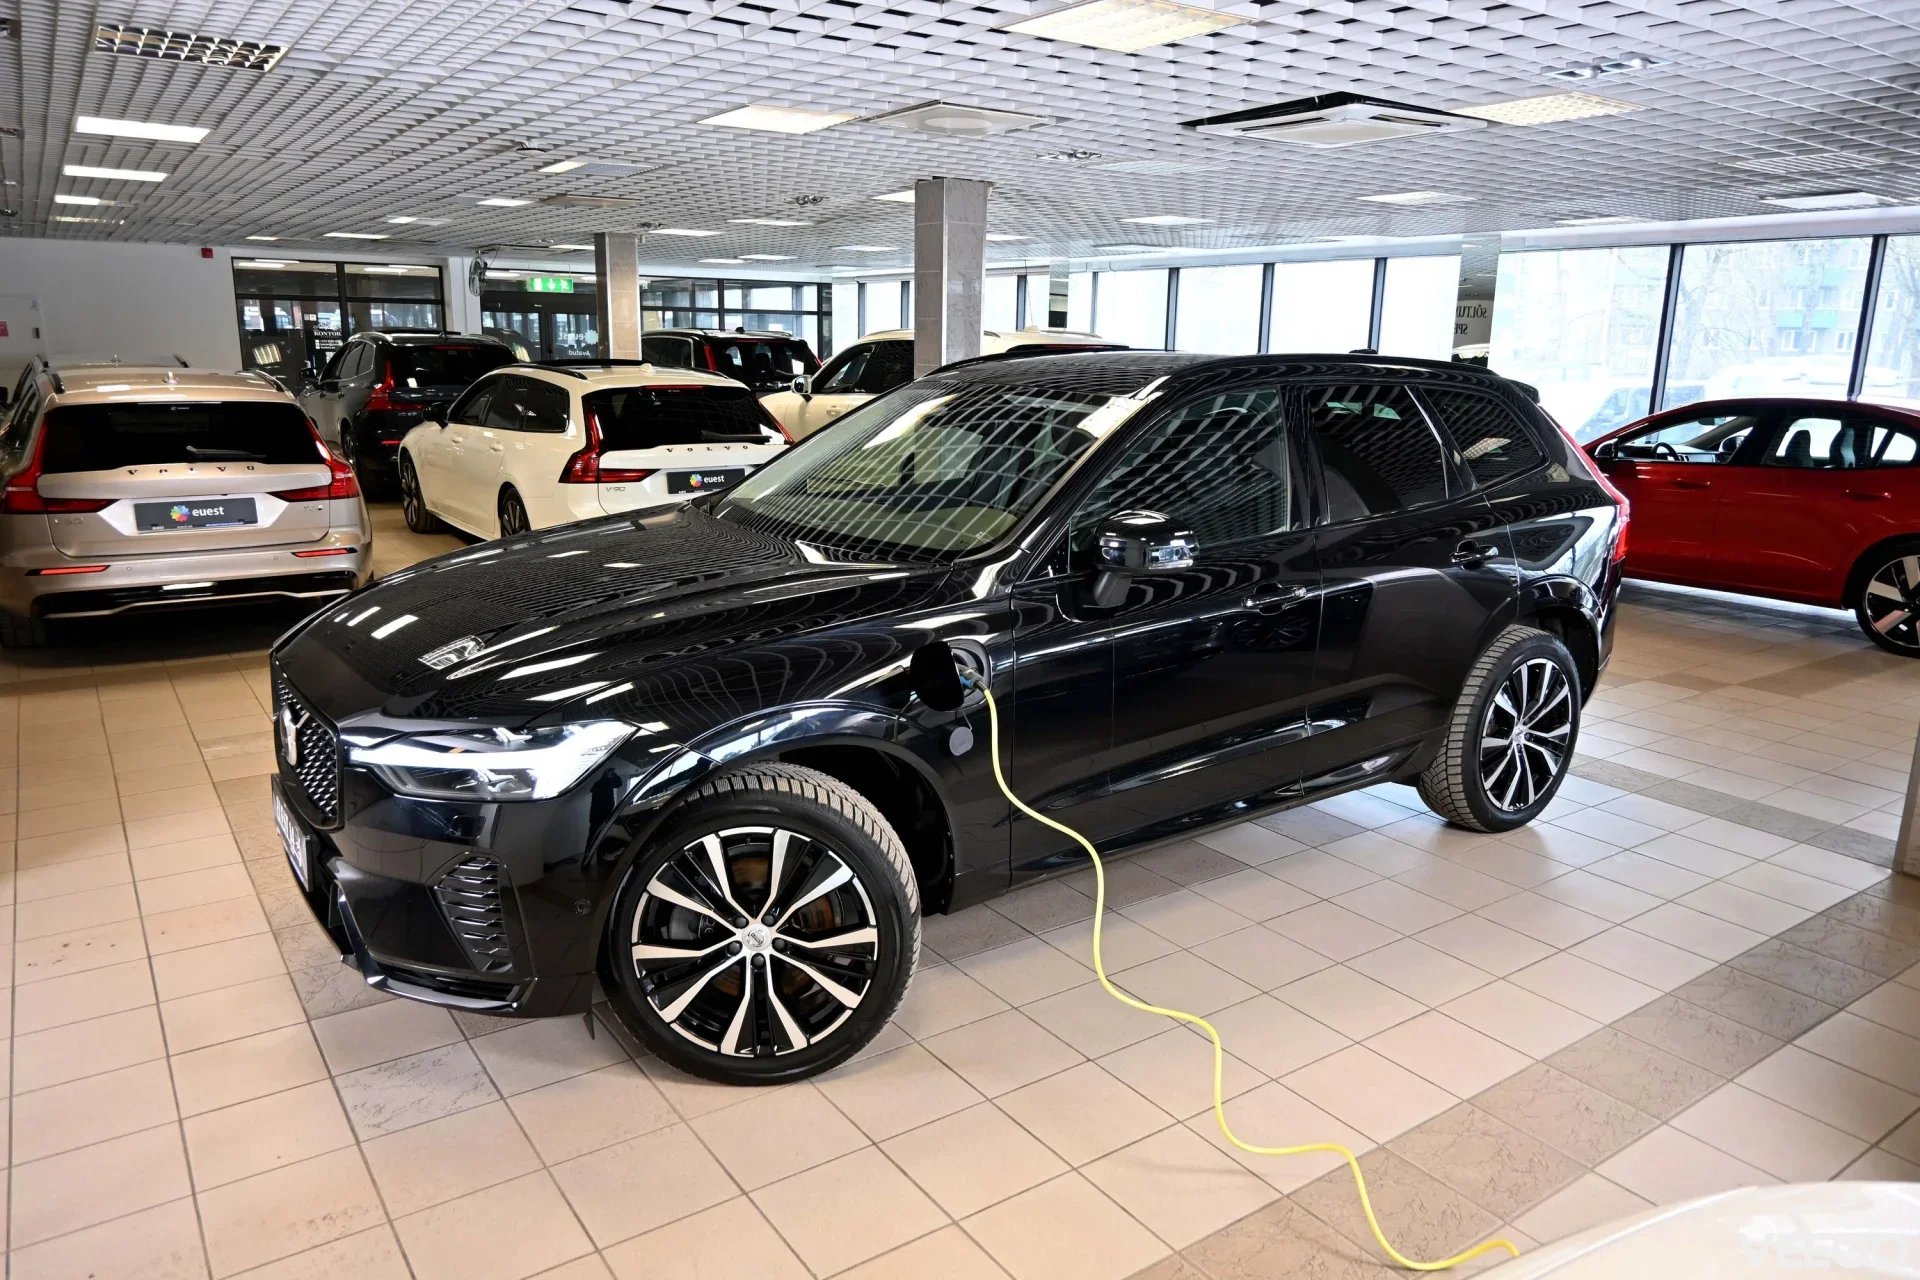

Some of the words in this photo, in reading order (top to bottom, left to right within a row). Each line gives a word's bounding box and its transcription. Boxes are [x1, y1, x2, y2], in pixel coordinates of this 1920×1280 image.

[666, 445, 749, 453] VOLVO
[704, 475, 725, 484] euest
[192, 506, 225, 517] euest
